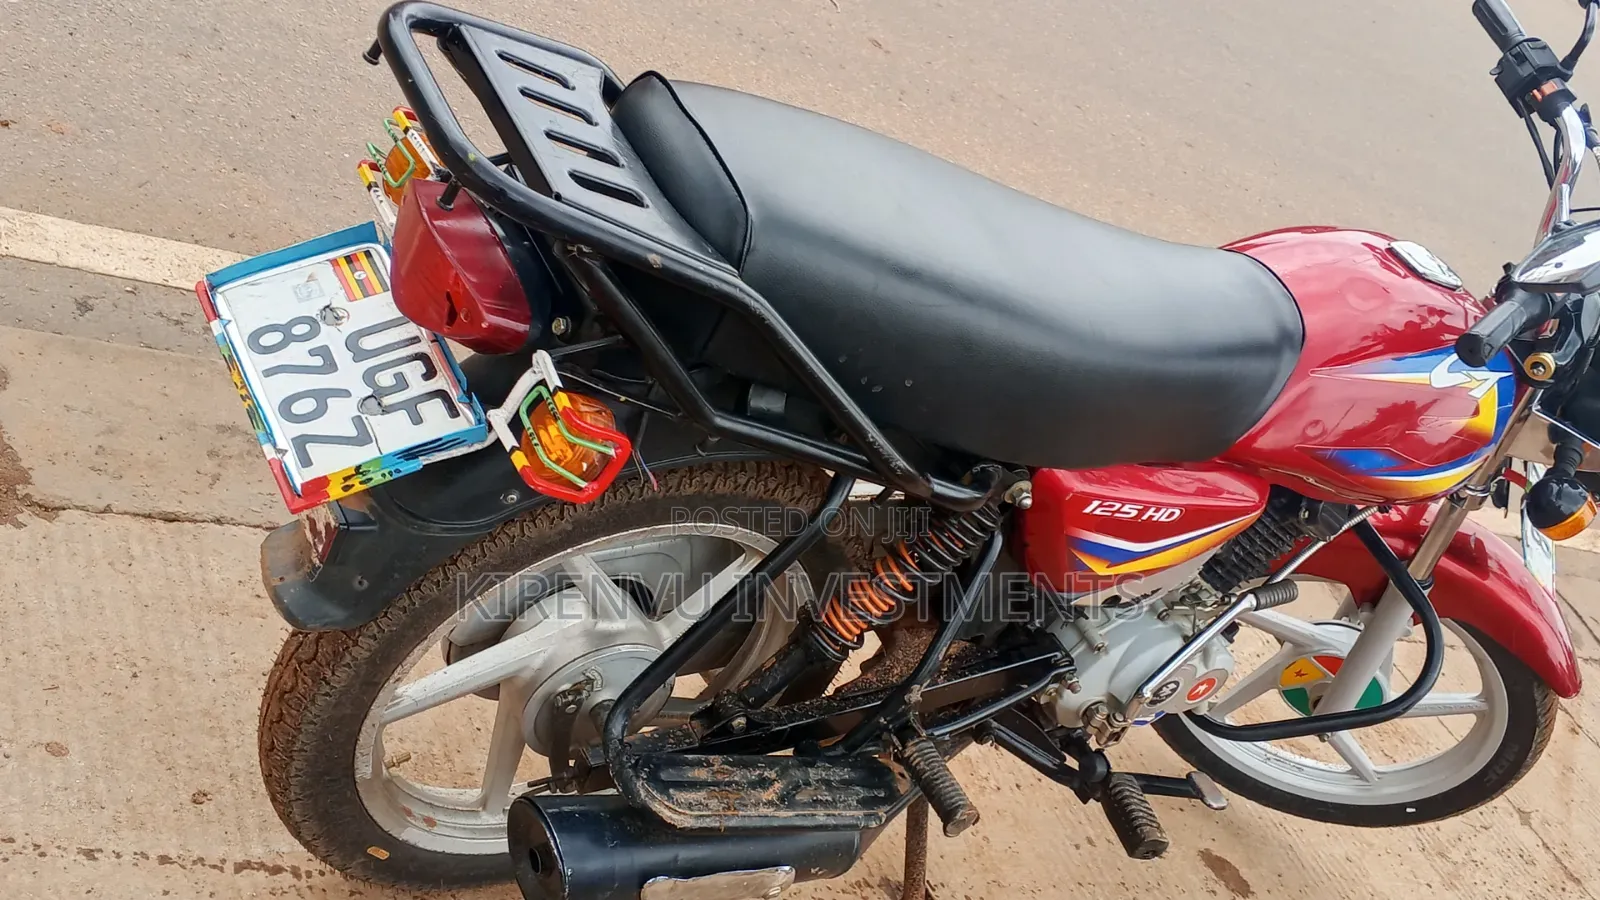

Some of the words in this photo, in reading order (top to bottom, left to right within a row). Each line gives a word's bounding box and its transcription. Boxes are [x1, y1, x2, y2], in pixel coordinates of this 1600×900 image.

[247, 315, 373, 468] 876Z
[345, 316, 461, 425] UGF
[1082, 500, 1144, 518] 125
[1141, 507, 1181, 522] HD
